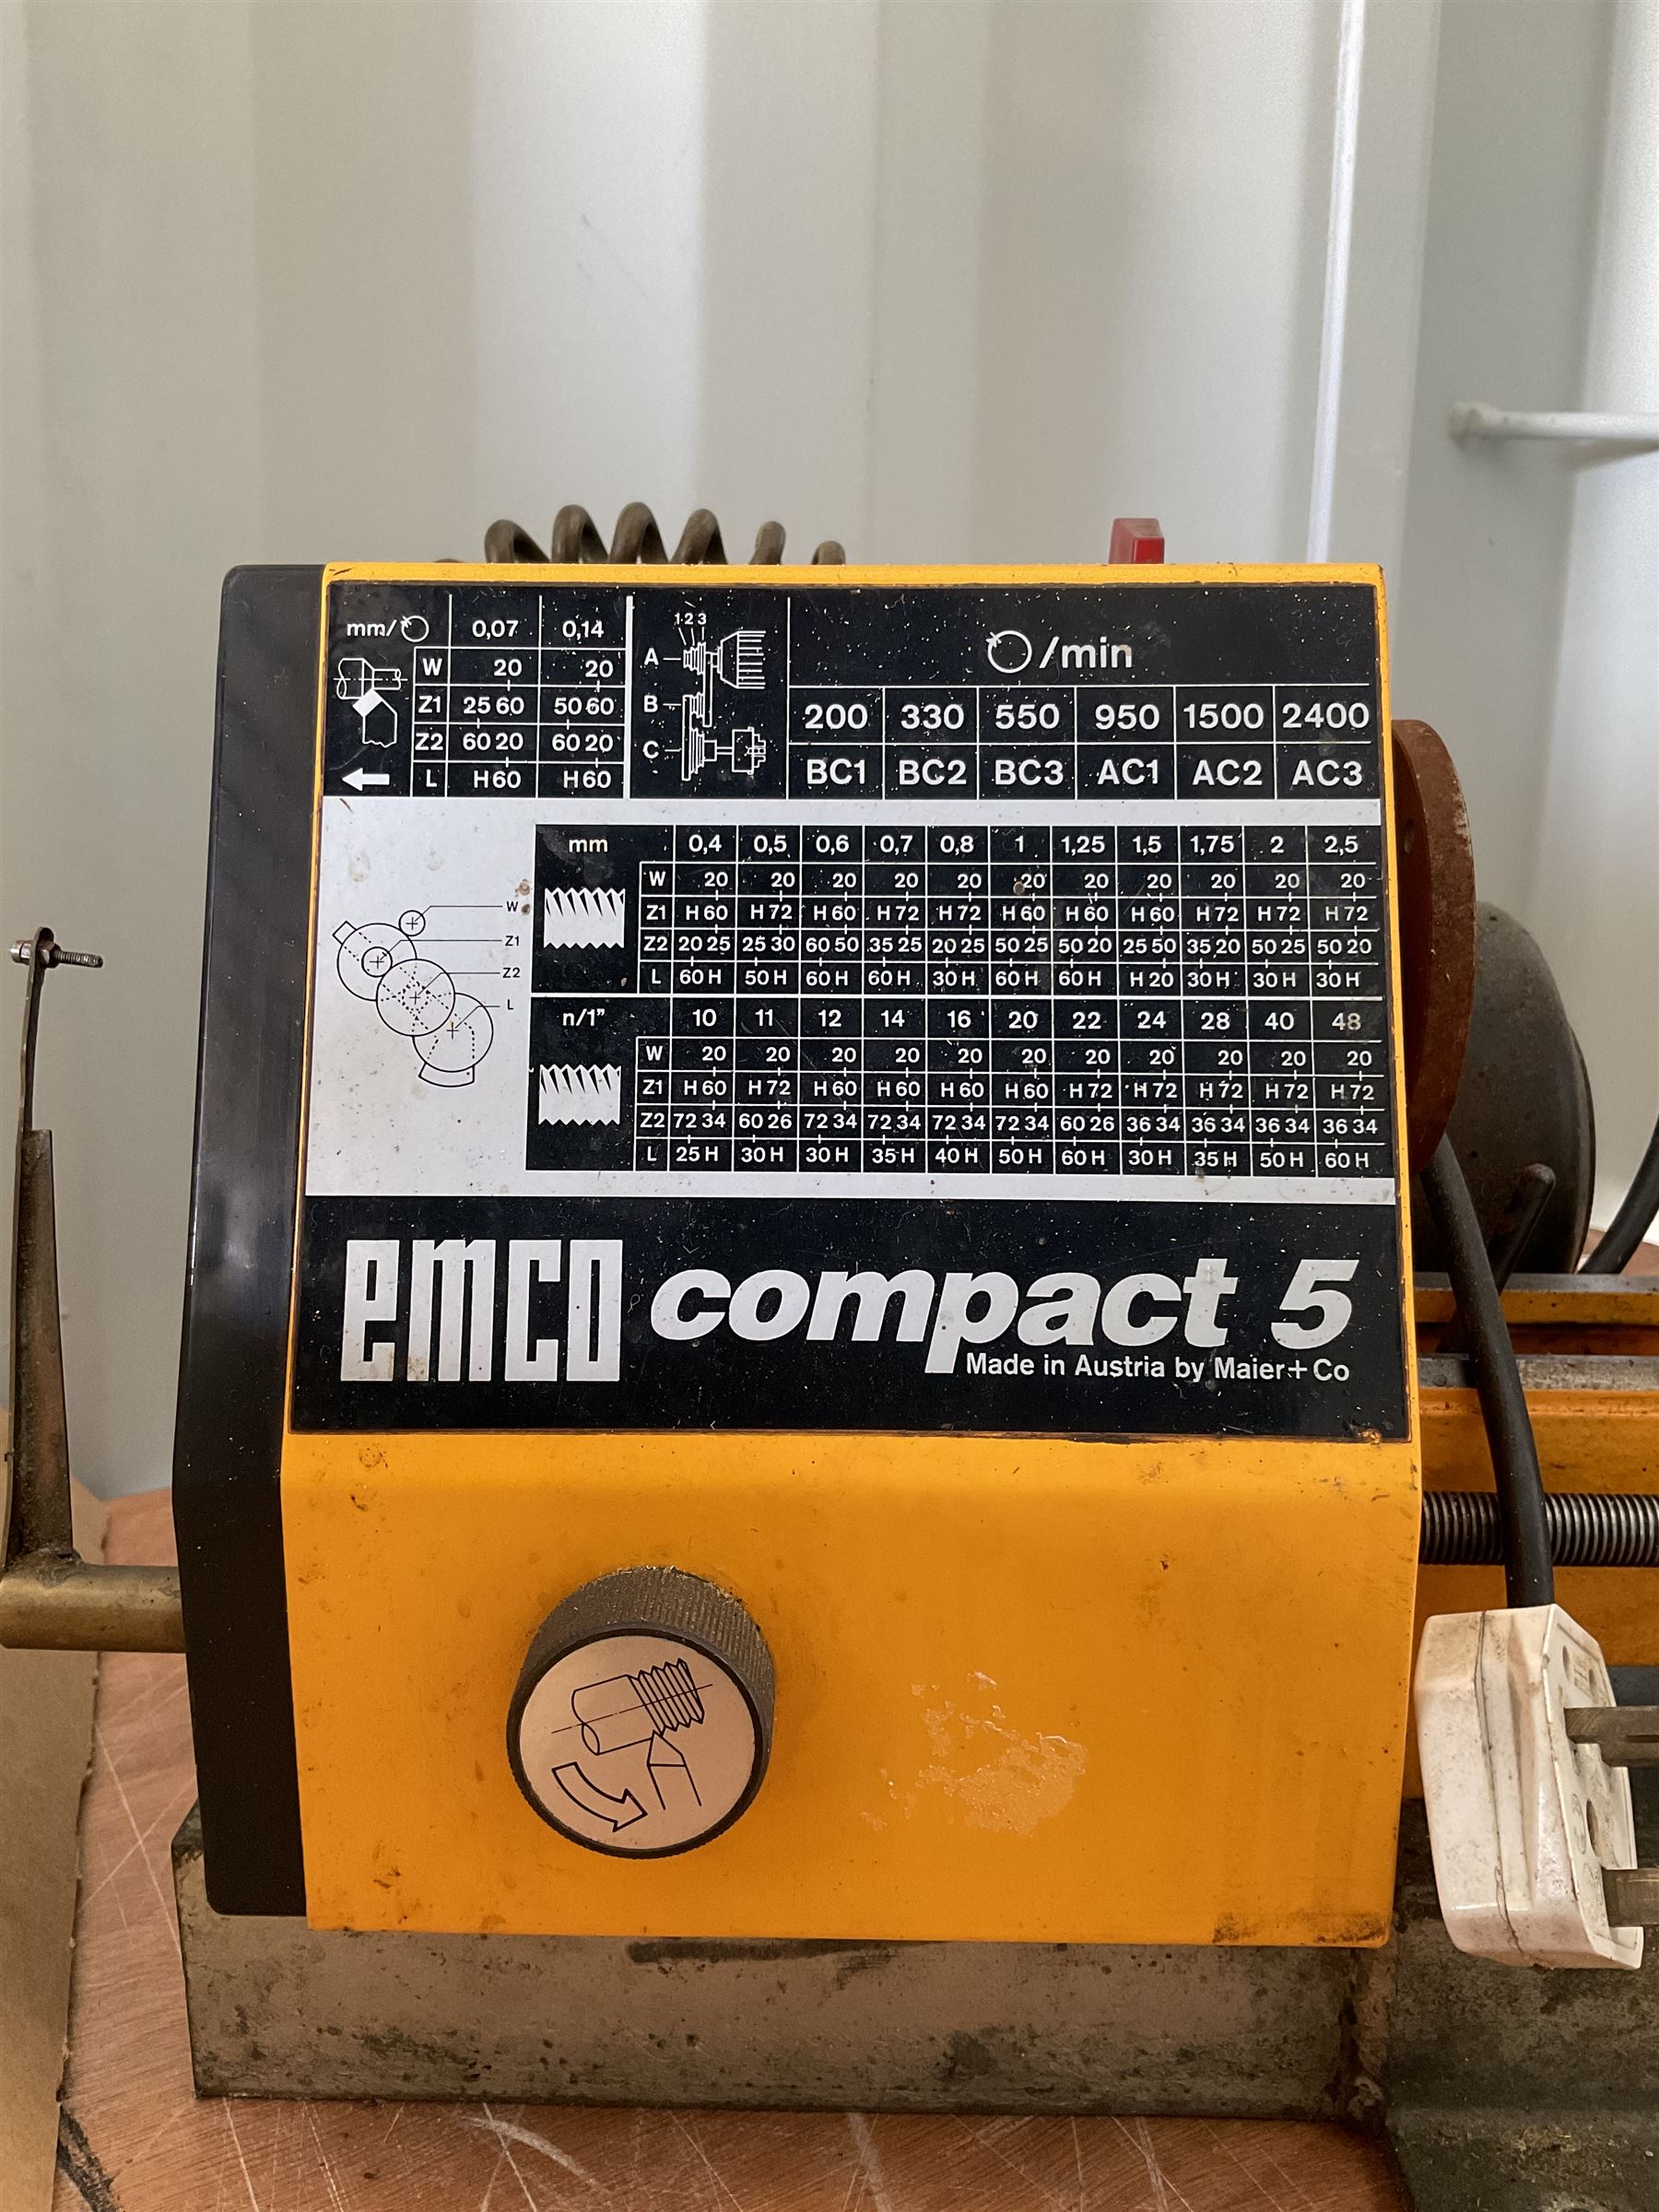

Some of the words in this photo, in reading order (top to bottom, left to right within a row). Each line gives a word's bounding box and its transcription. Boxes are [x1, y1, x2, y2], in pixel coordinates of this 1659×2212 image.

[347, 618, 397, 639] mm/
[472, 619, 519, 641] 0,07
[562, 619, 605, 641] 0,14
[643, 647, 659, 665] A
[1039, 635, 1134, 669] /min
[422, 657, 443, 677] W
[493, 658, 523, 677] 20
[584, 659, 614, 678] 20
[643, 694, 659, 713] B
[805, 703, 868, 730] 200
[900, 703, 965, 730] 330
[994, 703, 1060, 730] 550
[1095, 703, 1160, 730] 950
[1182, 702, 1265, 729] 1500
[1282, 702, 1370, 729] 2400
[641, 740, 659, 759] C
[806, 757, 865, 785] BC1
[899, 759, 967, 785] BC2
[994, 759, 1064, 786] BC3
[1097, 758, 1159, 785] AC1
[1192, 759, 1263, 786] AC2
[1291, 759, 1363, 787] AC3
[569, 839, 608, 853] mm
[688, 833, 723, 855] 0,4
[753, 834, 787, 856] 0,5
[815, 834, 850, 856] 0,6
[879, 834, 913, 856] 0,7
[939, 834, 974, 856] 0,8
[1014, 835, 1024, 853] 1
[1061, 835, 1106, 856] 1,25
[1132, 835, 1162, 856] 1,5
[1190, 834, 1235, 856] 1,75
[1269, 835, 1285, 853] 2
[1324, 835, 1359, 856] 2,5
[648, 870, 666, 887] W
[704, 871, 729, 888] 20
[770, 872, 795, 888] 20
[832, 872, 857, 888] 20
[894, 872, 919, 888] 20
[957, 873, 982, 889] 20
[1020, 873, 1047, 889] 20
[1084, 873, 1110, 889] 20
[1147, 873, 1172, 889] 20
[1210, 873, 1236, 889] 20
[1275, 873, 1300, 889] 20
[1340, 873, 1366, 888] 20
[505, 900, 519, 912] W
[645, 904, 666, 921] Z1
[504, 935, 520, 947] Z1
[501, 966, 522, 979] Z2
[651, 968, 662, 984] L
[507, 998, 514, 1011] L
[692, 1008, 717, 1027] 10
[755, 1008, 773, 1027] 11
[818, 1008, 842, 1028] 12
[880, 1009, 905, 1028] 14
[947, 1009, 971, 1029] 16
[1008, 1010, 1039, 1030] 20
[1072, 1011, 1101, 1030] 22
[1136, 1010, 1167, 1030] 24
[1200, 1011, 1230, 1030] 28
[1264, 1011, 1295, 1030] 40
[1331, 1012, 1361, 1030] 48
[645, 1045, 664, 1062] W
[701, 1045, 727, 1062] 20
[765, 1046, 791, 1063] 20
[831, 1046, 857, 1064] 20
[895, 1047, 921, 1064] 20
[958, 1047, 983, 1064] 20
[1021, 1047, 1047, 1065] 20
[1085, 1048, 1111, 1065] 20
[1148, 1049, 1175, 1065] 20
[1218, 1049, 1243, 1065] 20
[1280, 1050, 1307, 1067] 20
[1347, 1050, 1372, 1066] 20
[641, 1078, 663, 1095] Z1
[651, 1258, 1238, 1373] compact
[1271, 1259, 1359, 1349] 5
[967, 1353, 1034, 1374] Made
[1044, 1354, 1065, 1375] in
[1075, 1354, 1165, 1377] Austria
[1175, 1357, 1204, 1382] by
